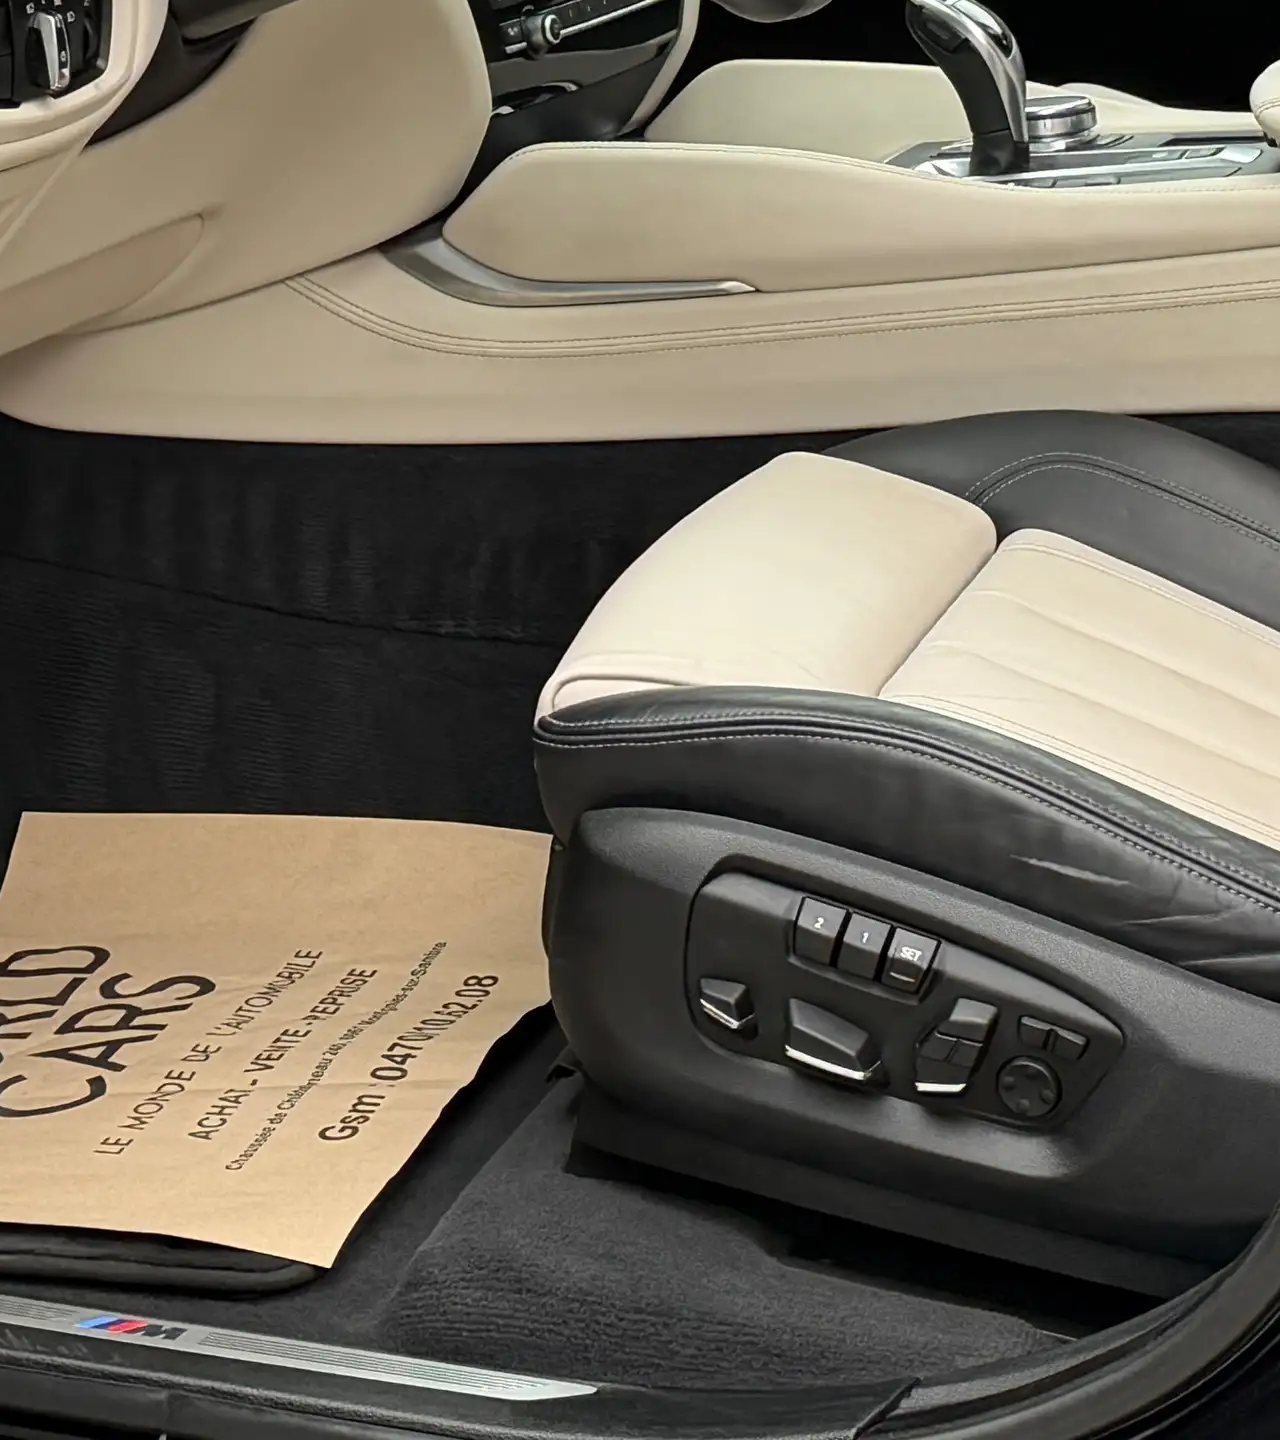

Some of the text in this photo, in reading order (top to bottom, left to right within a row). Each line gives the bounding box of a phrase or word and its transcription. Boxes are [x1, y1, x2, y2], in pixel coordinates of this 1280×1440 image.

[814, 917, 825, 929] 2
[862, 932, 869, 944] 1
[900, 946, 923, 961] SET
[93, 949, 324, 1155] LE MONDE DE L'AUTOMOBILE
[187, 1088, 255, 1140] ACHAT
[243, 1028, 313, 1073] VENTE
[266, 1112, 288, 1125] de
[318, 1093, 387, 1141] Gsm
